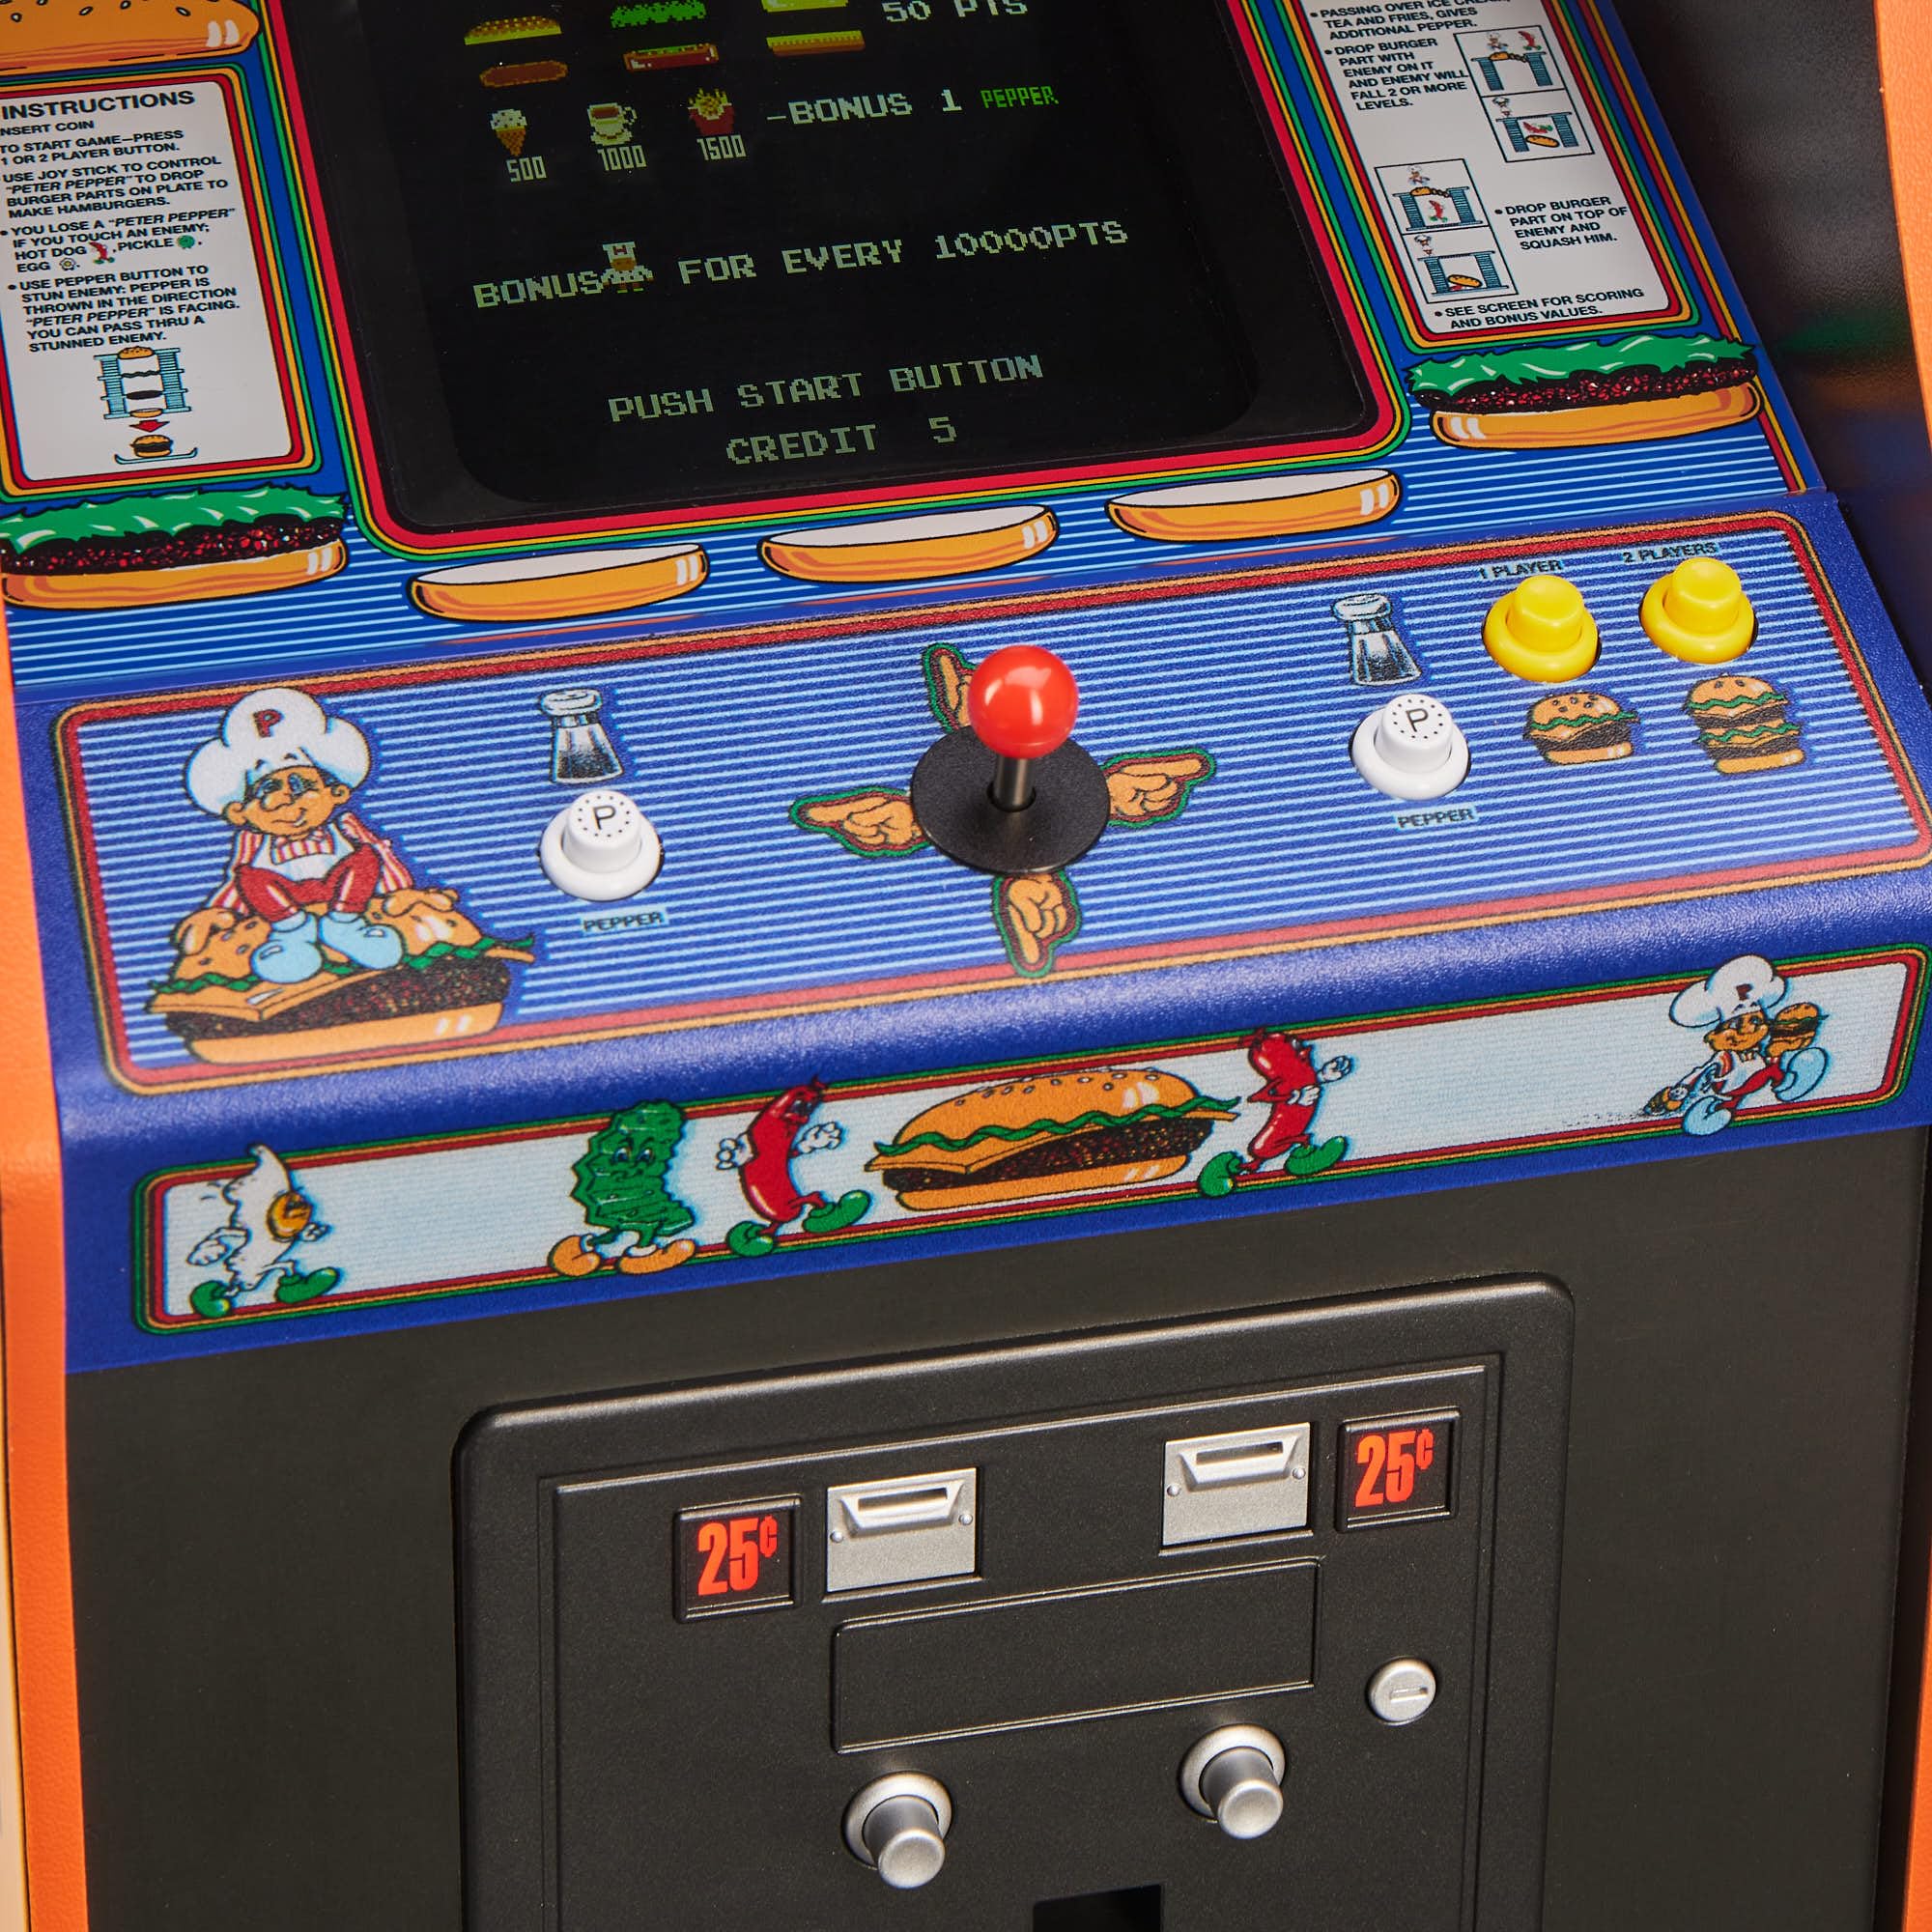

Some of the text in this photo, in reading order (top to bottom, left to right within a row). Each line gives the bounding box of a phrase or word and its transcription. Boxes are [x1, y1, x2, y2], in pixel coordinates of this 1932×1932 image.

[882, 1, 931, 22] 50
[1321, 4, 1380, 17] PASSING
[1384, 2, 1423, 12] OVER
[1324, 19, 1352, 29] TEA
[1356, 15, 1385, 25] AND
[1436, 7, 1478, 18] GIVES
[1330, 19, 1477, 40] ADDITIONAL PEPPER.
[1335, 38, 1437, 55] DROP BURGER
[1339, 52, 1414, 66] PART WITH
[1344, 61, 1434, 77] ENEMY ON IT
[1349, 70, 1468, 88] AND ENEMY WILL
[942, 89, 962, 111] 1
[980, 85, 1059, 108] PEPPER
[1350, 90, 1386, 99] FALL
[1400, 86, 1421, 96] OR
[1424, 81, 1467, 93] MORE
[2, 91, 195, 119] INSTRUCTIONS
[1356, 99, 1413, 110] LEVELS.
[0, 121, 94, 136] NSERT COIN
[0, 144, 19, 154] TO
[23, 139, 71, 152] START
[1, 142, 180, 166] 1 OR 2 PLAYER BUTTON.
[696, 134, 747, 160] 1500
[597, 145, 647, 171] 1000
[3, 156, 221, 183] USE JOY STICK TO CONTROL
[135, 174, 156, 184] TO
[160, 169, 204, 182] DROP
[506, 156, 547, 183] 500
[7, 180, 228, 207] BURGER PARTS ON PLATE TO
[9, 197, 170, 218] MAKE HAMBURGERS.
[1505, 196, 1611, 214] DROP BURGER
[1510, 207, 1628, 226] PART ON TOP OF
[11, 225, 44, 236] YOU
[48, 221, 89, 234] LOSE
[94, 219, 104, 229] A
[1515, 222, 1600, 238] ENEMY AND
[13, 238, 26, 248] IF
[31, 236, 64, 246] YOU
[70, 230, 123, 243] TOUCH
[127, 229, 148, 239] AN
[1520, 233, 1617, 250] SQUASH HIM.
[15, 249, 47, 261] HOT
[51, 246, 87, 257] DOG
[473, 220, 1128, 308] BONUS FOR EVERY 10000PTS
[17, 261, 50, 272] EGG
[19, 265, 209, 291] USE PEPPER BUTTON TO
[22, 290, 64, 302] STUN
[129, 279, 191, 293] PEPPER
[195, 277, 210, 287] IS
[23, 287, 237, 316] THROWN IN THE DIRECTION
[159, 303, 174, 314] IS
[179, 299, 240, 313] FACING.
[1445, 289, 1644, 317] SEE SCREEN FOR SCORING
[27, 316, 205, 340] YOU CAN PASS THRU A
[1450, 306, 1603, 329] AND BONUS VALUES.
[29, 331, 166, 353] STUNNED ENEMY.
[608, 355, 1044, 423] PUSH START BUTTON
[725, 417, 956, 465] CREDIT 5
[1623, 543, 1717, 562] 2 PLAYERS
[1479, 560, 1562, 579] 1 PLAYER
[1406, 708, 1429, 732] P
[593, 805, 616, 830] P
[1397, 808, 1474, 829] PEPPER
[583, 912, 664, 931] PEPPER
